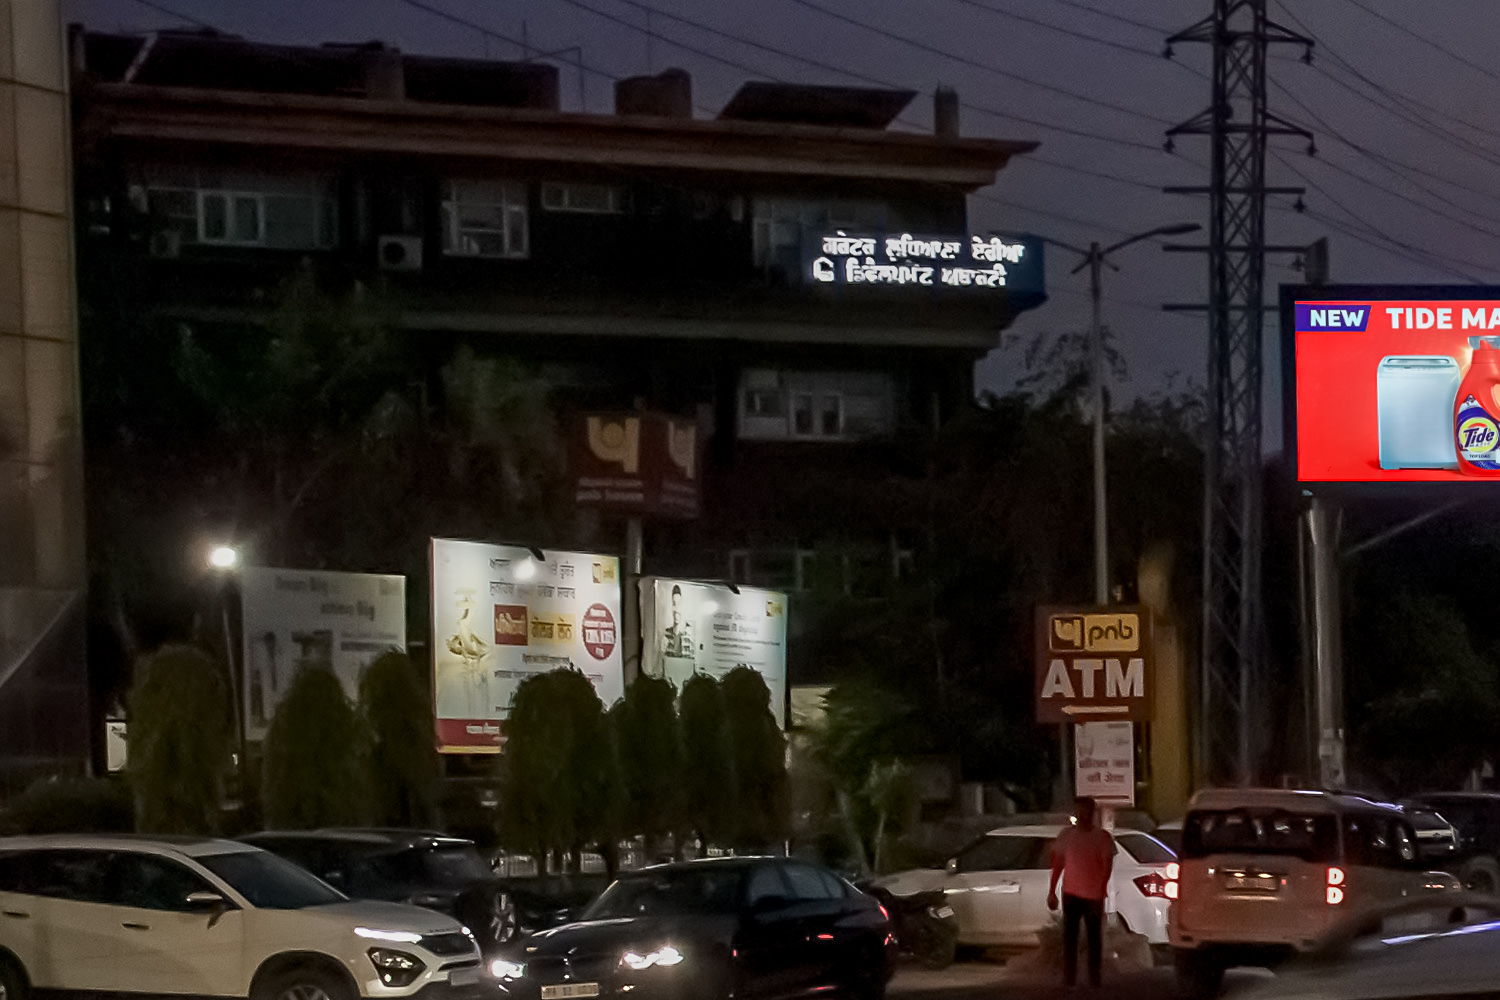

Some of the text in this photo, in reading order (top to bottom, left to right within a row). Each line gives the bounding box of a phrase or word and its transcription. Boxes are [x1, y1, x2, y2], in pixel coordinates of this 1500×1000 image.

[1310, 309, 1364, 327] NEW
[1386, 307, 1453, 329] TIDE
[1463, 426, 1495, 447] Tide
[1088, 618, 1133, 647] pnb
[1041, 658, 1144, 698] ATM
